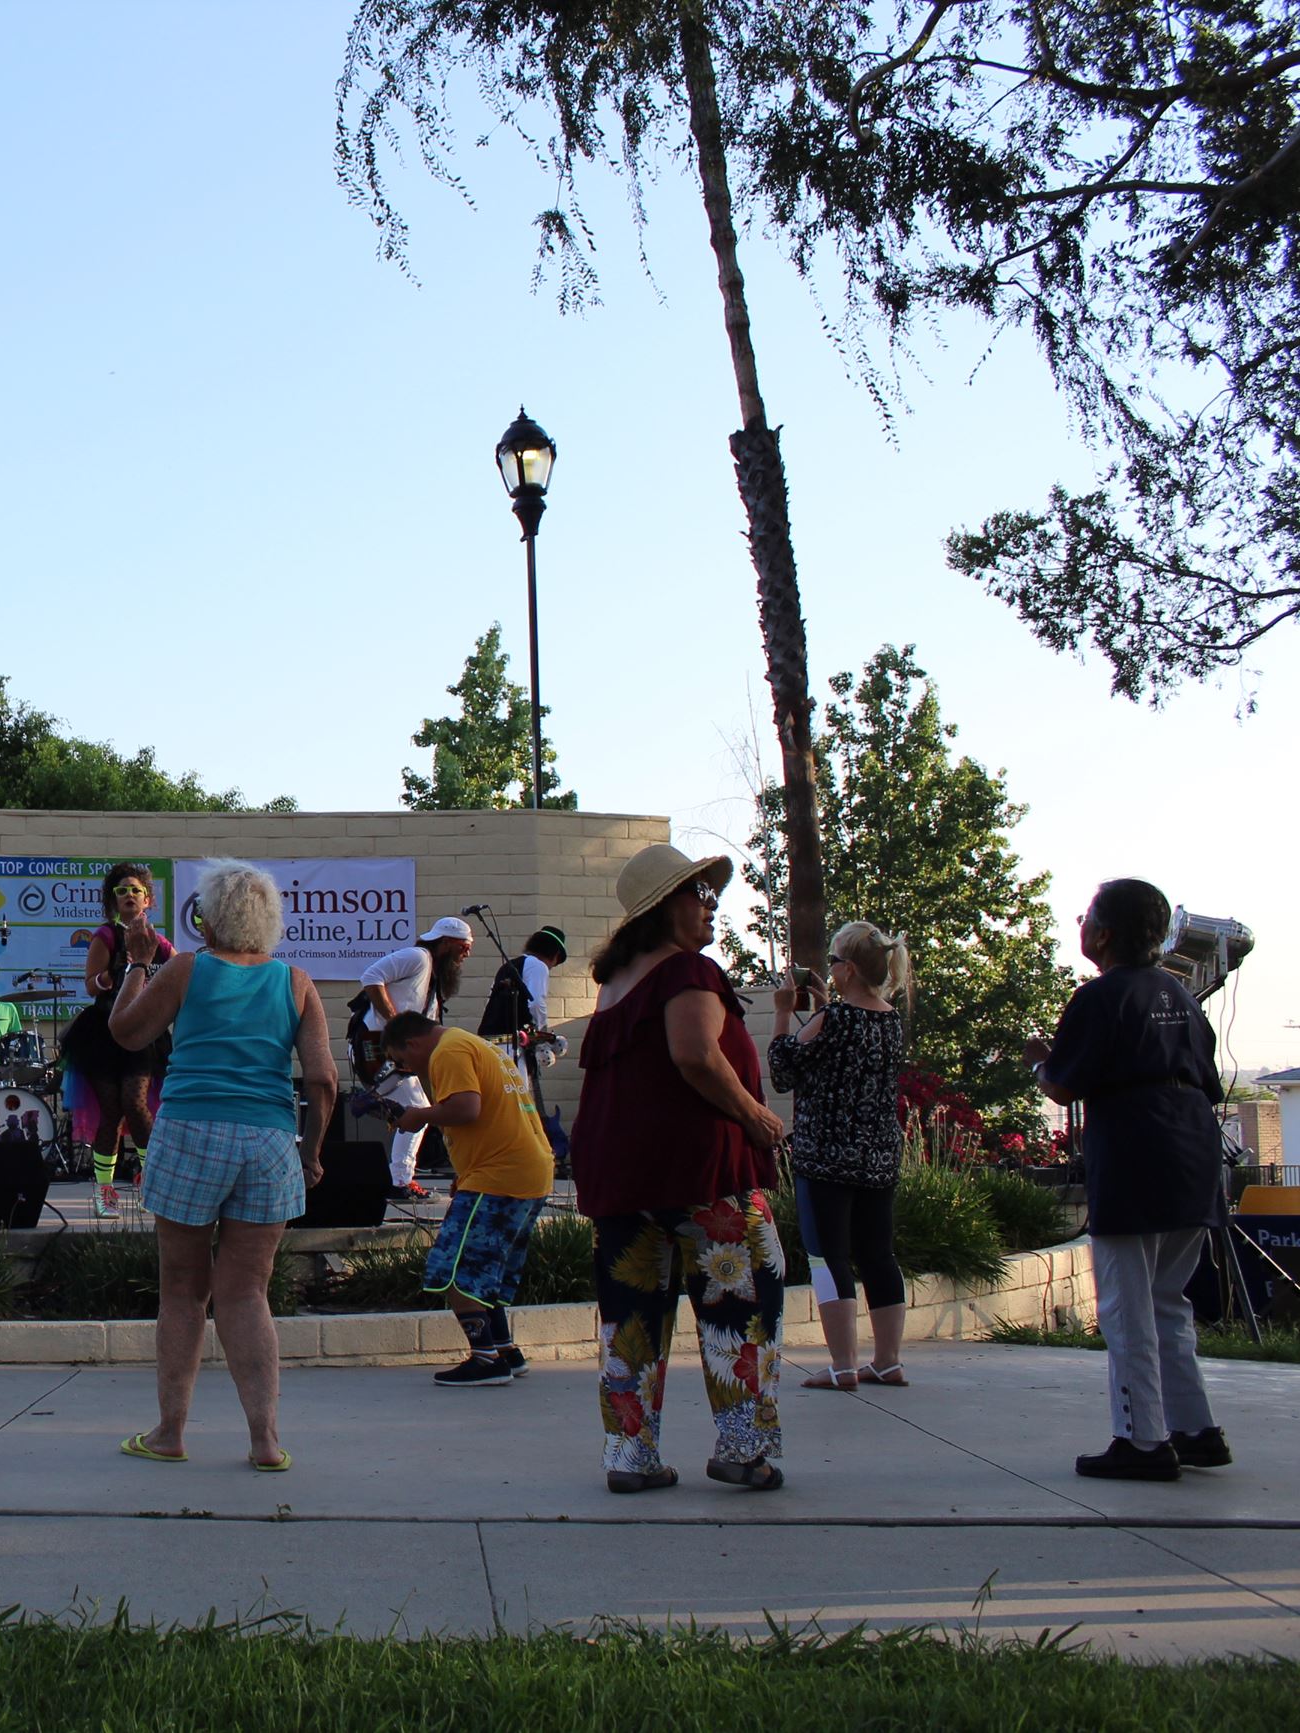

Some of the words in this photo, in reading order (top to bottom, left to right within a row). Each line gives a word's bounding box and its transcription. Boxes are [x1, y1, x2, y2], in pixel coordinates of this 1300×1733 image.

[0, 861, 24, 875] TOP
[28, 862, 84, 876] CONCERT
[281, 880, 409, 914] rimson
[53, 906, 102, 918] Midstre
[285, 918, 352, 945] eline,
[356, 918, 409, 941] LLC
[288, 949, 298, 958] of
[299, 949, 336, 959] Crimson
[22, 1004, 62, 1016] THANK
[67, 1005, 84, 1016] YO
